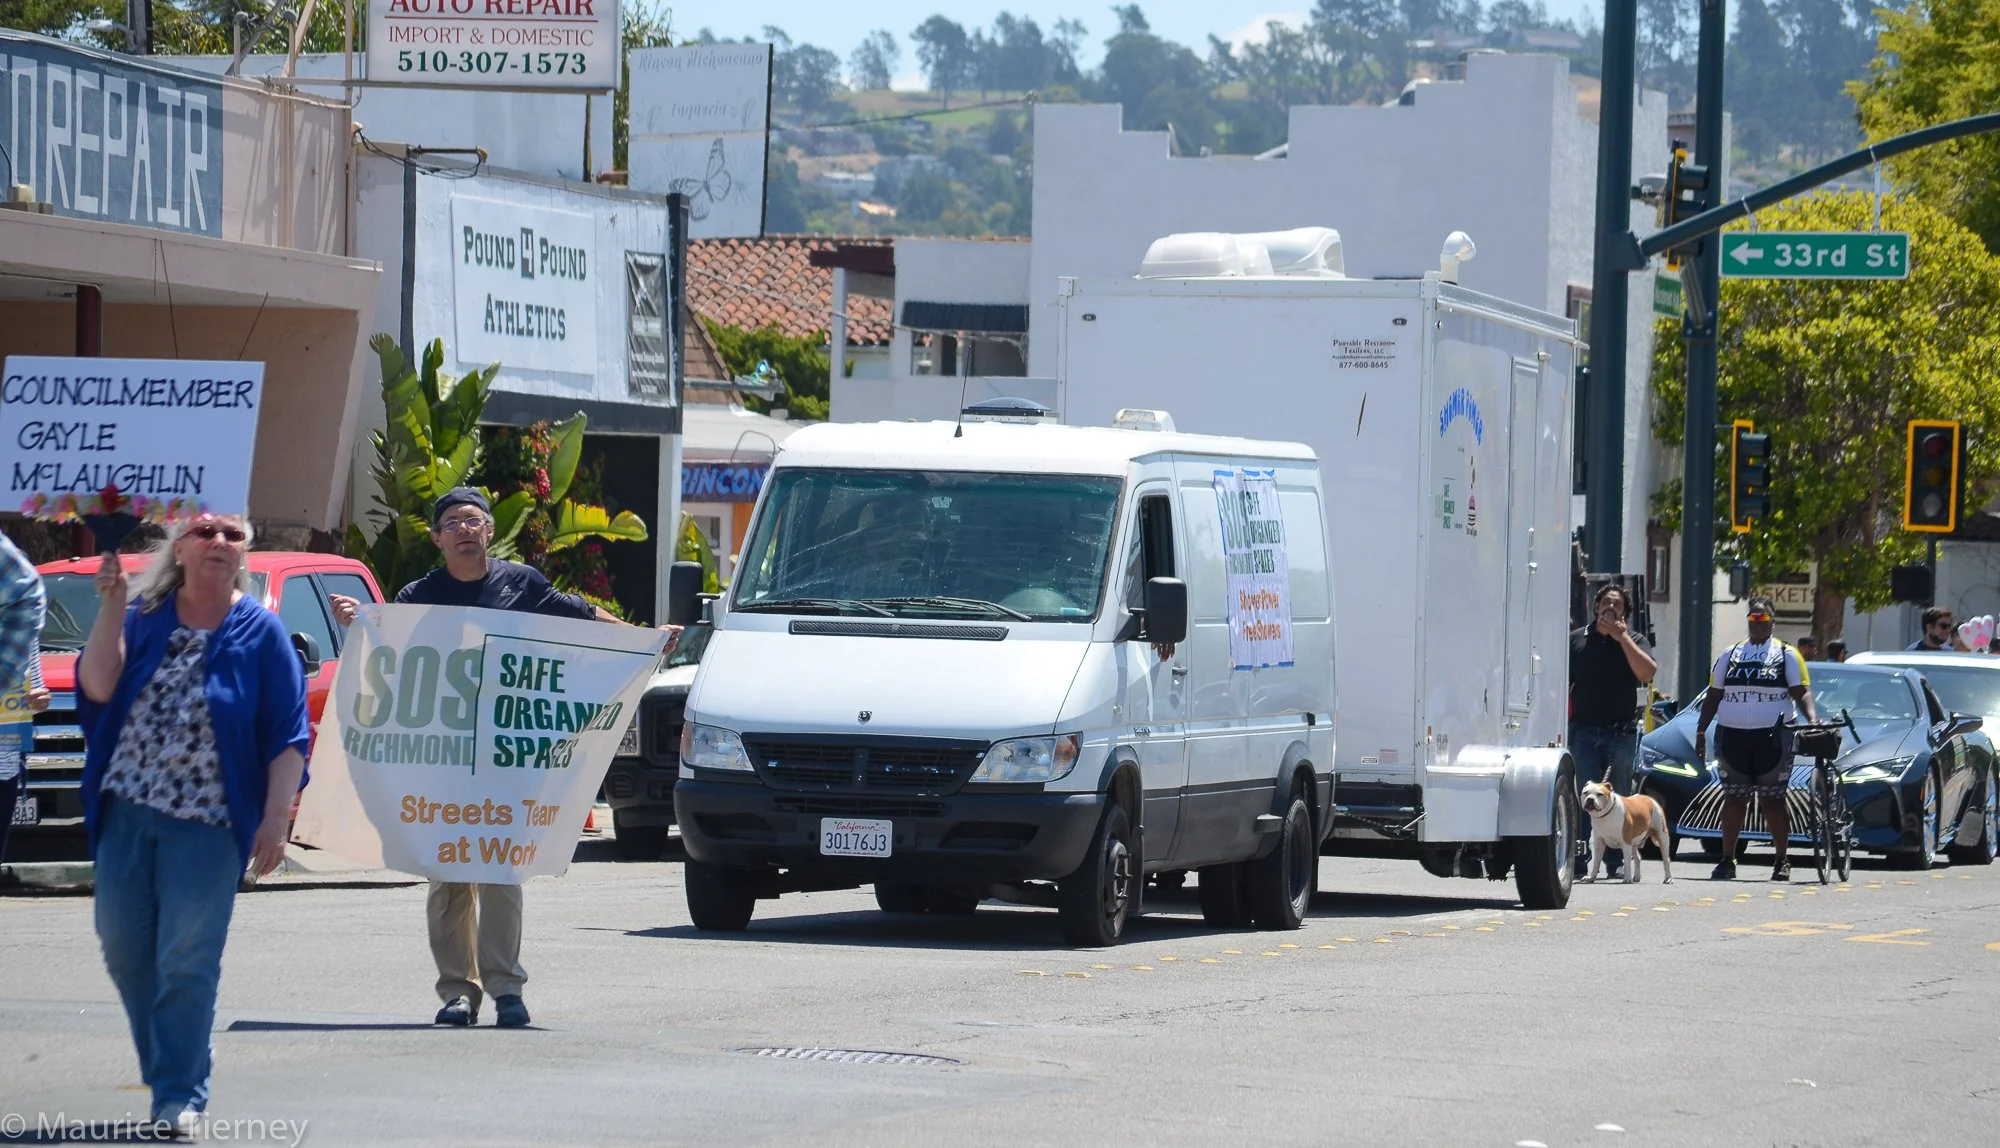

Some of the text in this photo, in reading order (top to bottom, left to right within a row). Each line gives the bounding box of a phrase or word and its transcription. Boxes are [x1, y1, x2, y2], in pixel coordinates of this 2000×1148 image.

[389, 0, 595, 16] AUTO REPAIR
[388, 25, 595, 47] IMPORT & DOMESTIC
[397, 50, 588, 75] 510-307-1573
[520, 227, 535, 280] 4
[1774, 243, 1900, 268] 33rd St
[1338, 361, 1389, 369] 877-600-8645
[2, 375, 254, 409] COUNCILMEMBER
[17, 421, 117, 451] GAYLE
[1725, 666, 1778, 681] LIVES
[352, 645, 565, 731] SOS SAFE
[343, 725, 475, 767] RICHMOND
[400, 794, 513, 825] Streets
[437, 835, 538, 866] at Work
[825, 832, 887, 851] 30176J3
